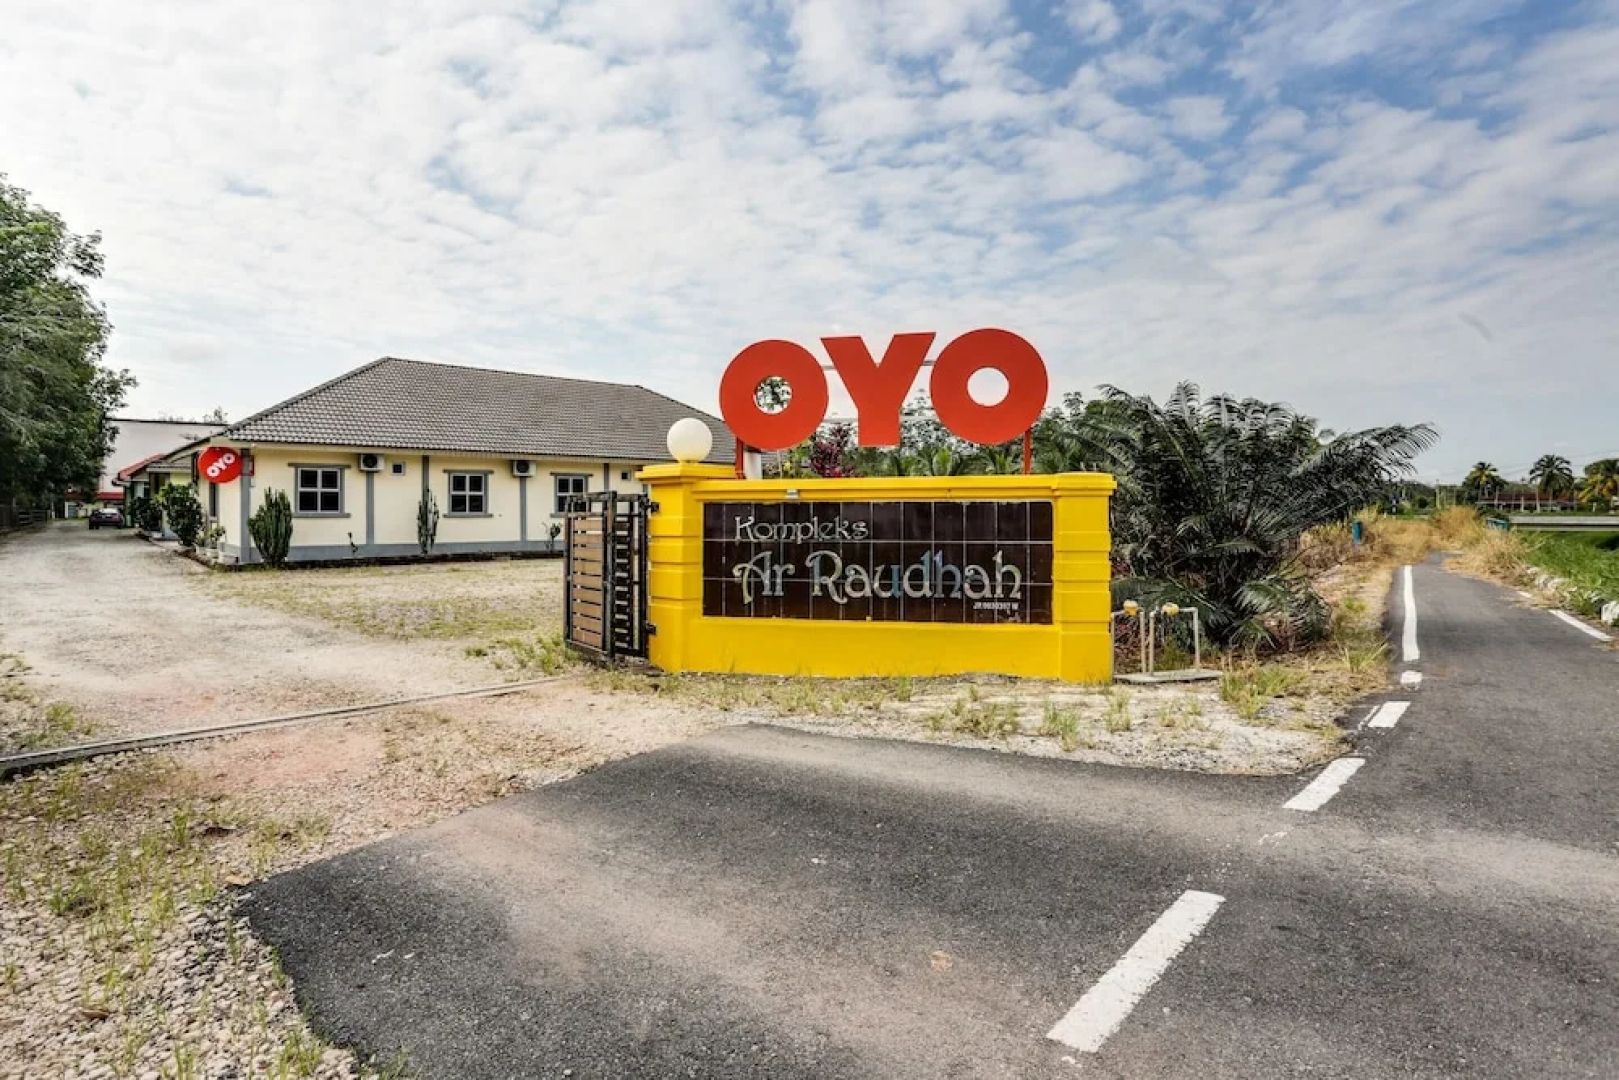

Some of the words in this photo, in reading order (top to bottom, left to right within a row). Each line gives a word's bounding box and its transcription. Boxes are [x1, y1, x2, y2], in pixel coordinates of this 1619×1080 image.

[719, 328, 1048, 450] OYO
[207, 453, 235, 477] OYO
[735, 516, 868, 544] Kompleks
[732, 551, 795, 604] Ar
[805, 550, 1021, 604] Raudhah
